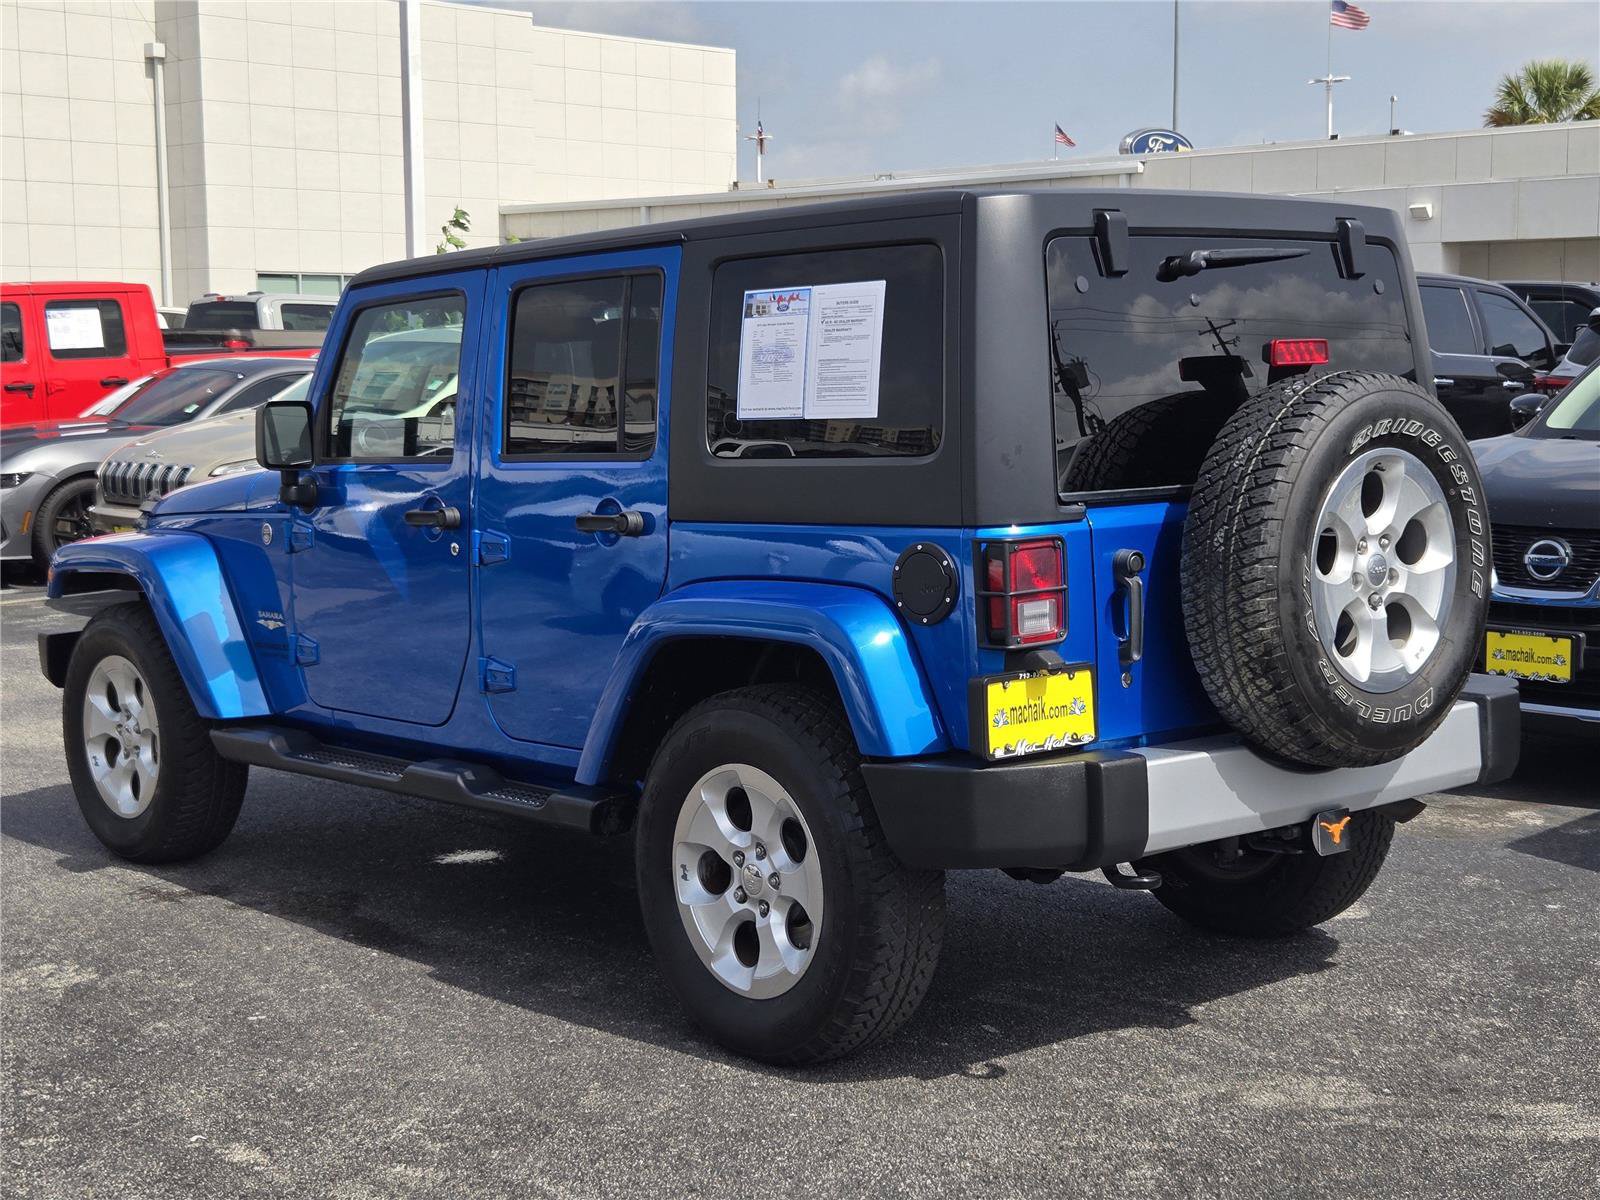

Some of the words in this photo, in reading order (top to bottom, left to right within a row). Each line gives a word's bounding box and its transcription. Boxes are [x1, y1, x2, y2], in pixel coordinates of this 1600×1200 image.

[1349, 417, 1482, 600] BRIDGESTONE
[1505, 647, 1552, 664] machaik.com
[1319, 657, 1434, 724] DUELER
[1010, 696, 1068, 725] machaik.com
[1015, 739, 1042, 757] Mac
[1044, 731, 1073, 750] Haik
